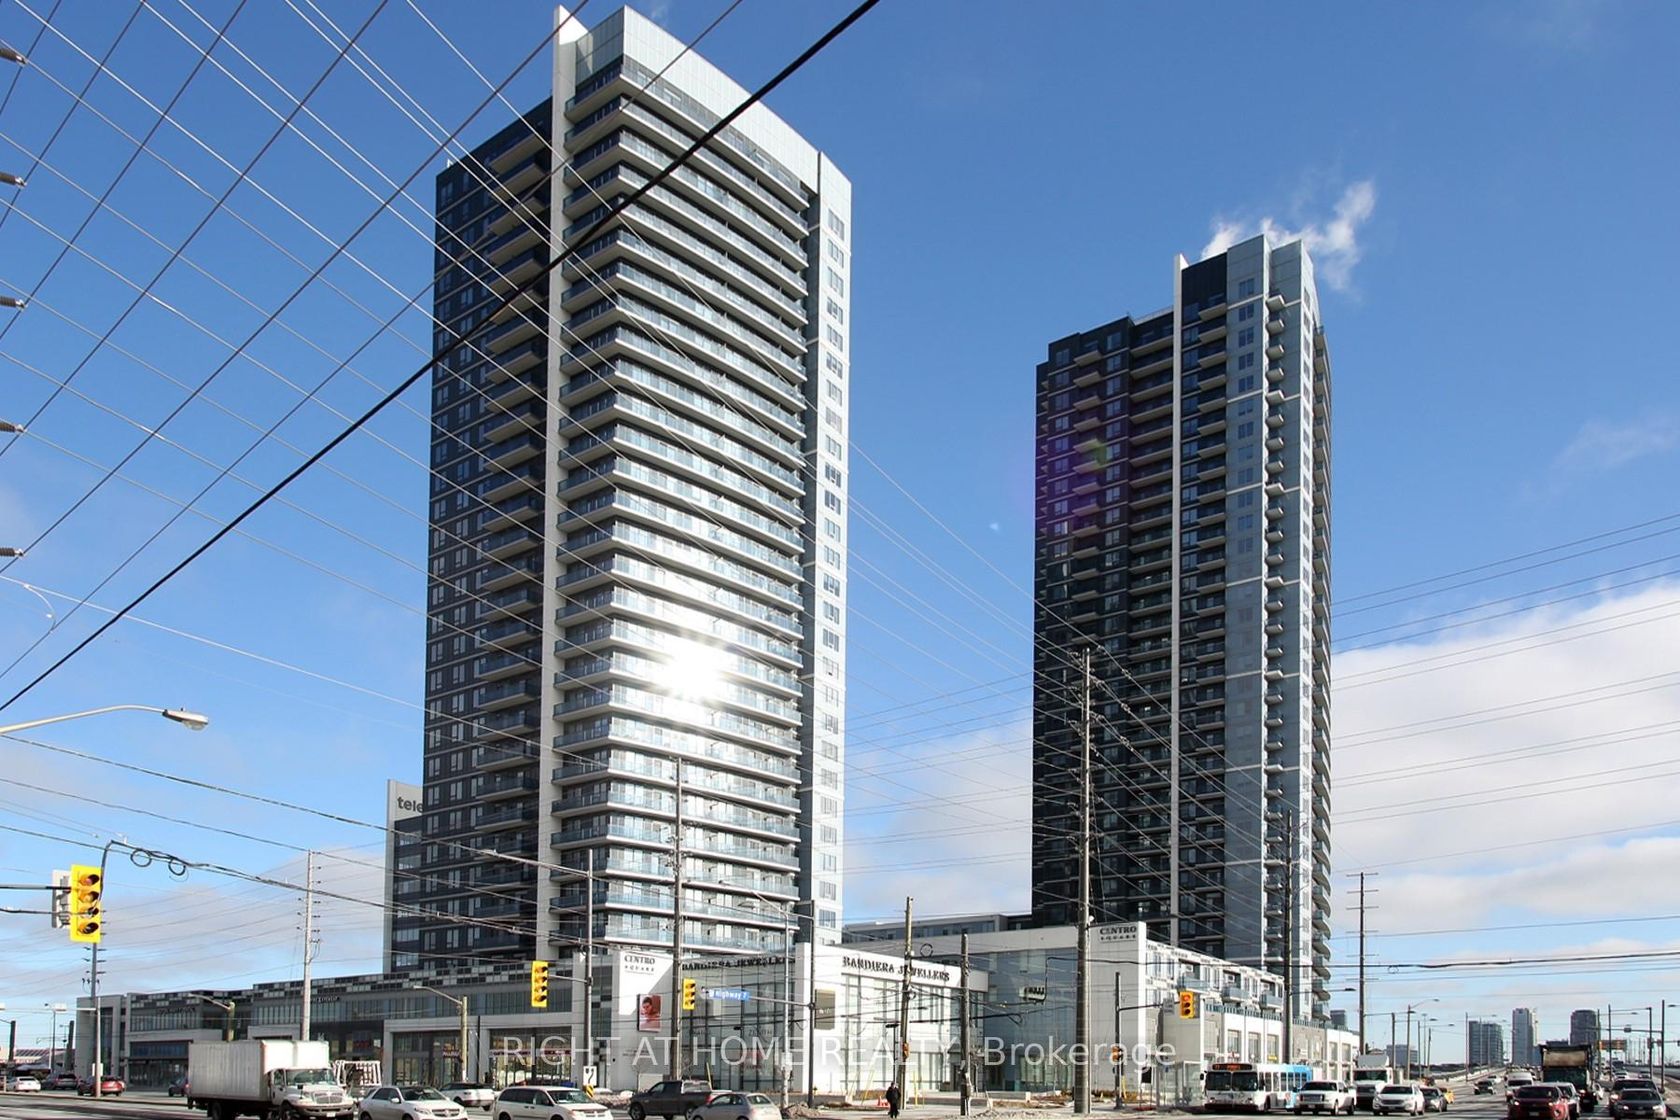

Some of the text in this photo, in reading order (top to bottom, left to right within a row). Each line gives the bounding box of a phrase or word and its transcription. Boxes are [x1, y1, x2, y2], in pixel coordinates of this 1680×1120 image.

[624, 955, 656, 965] CENTRO
[843, 956, 950, 981] BANDIERA JWELLERS
